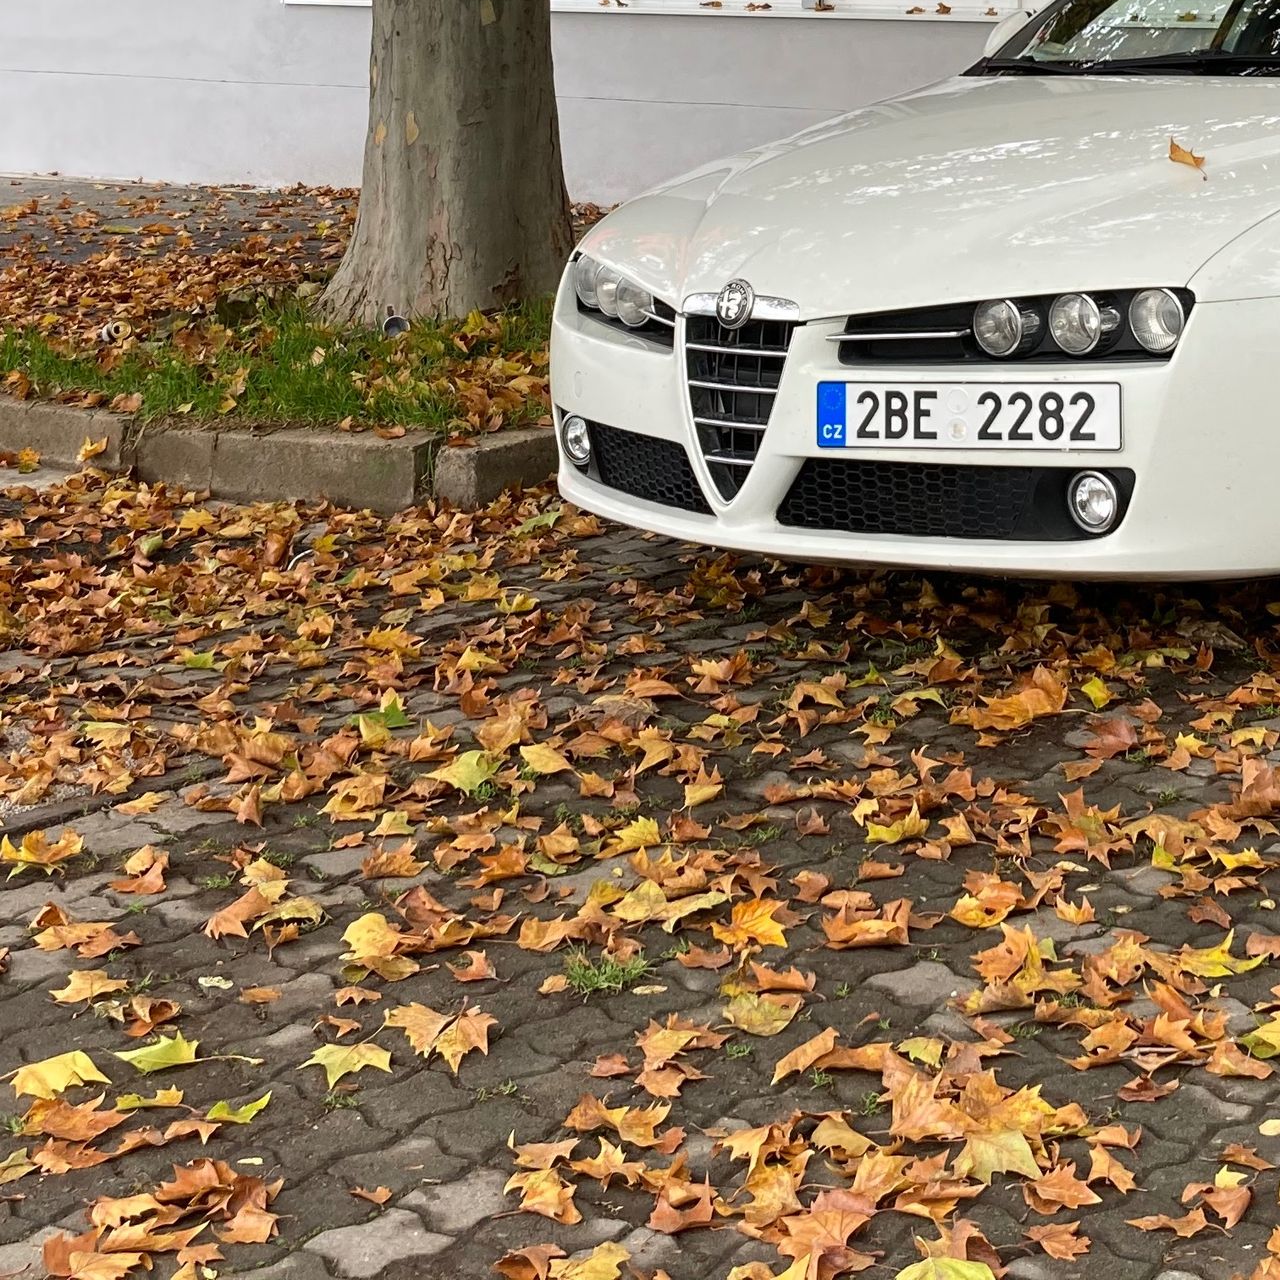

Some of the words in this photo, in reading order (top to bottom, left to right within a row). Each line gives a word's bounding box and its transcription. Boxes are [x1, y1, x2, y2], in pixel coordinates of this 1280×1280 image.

[822, 424, 843, 439] CZ
[856, 390, 938, 440] 2BE
[977, 391, 1096, 441] 2282
